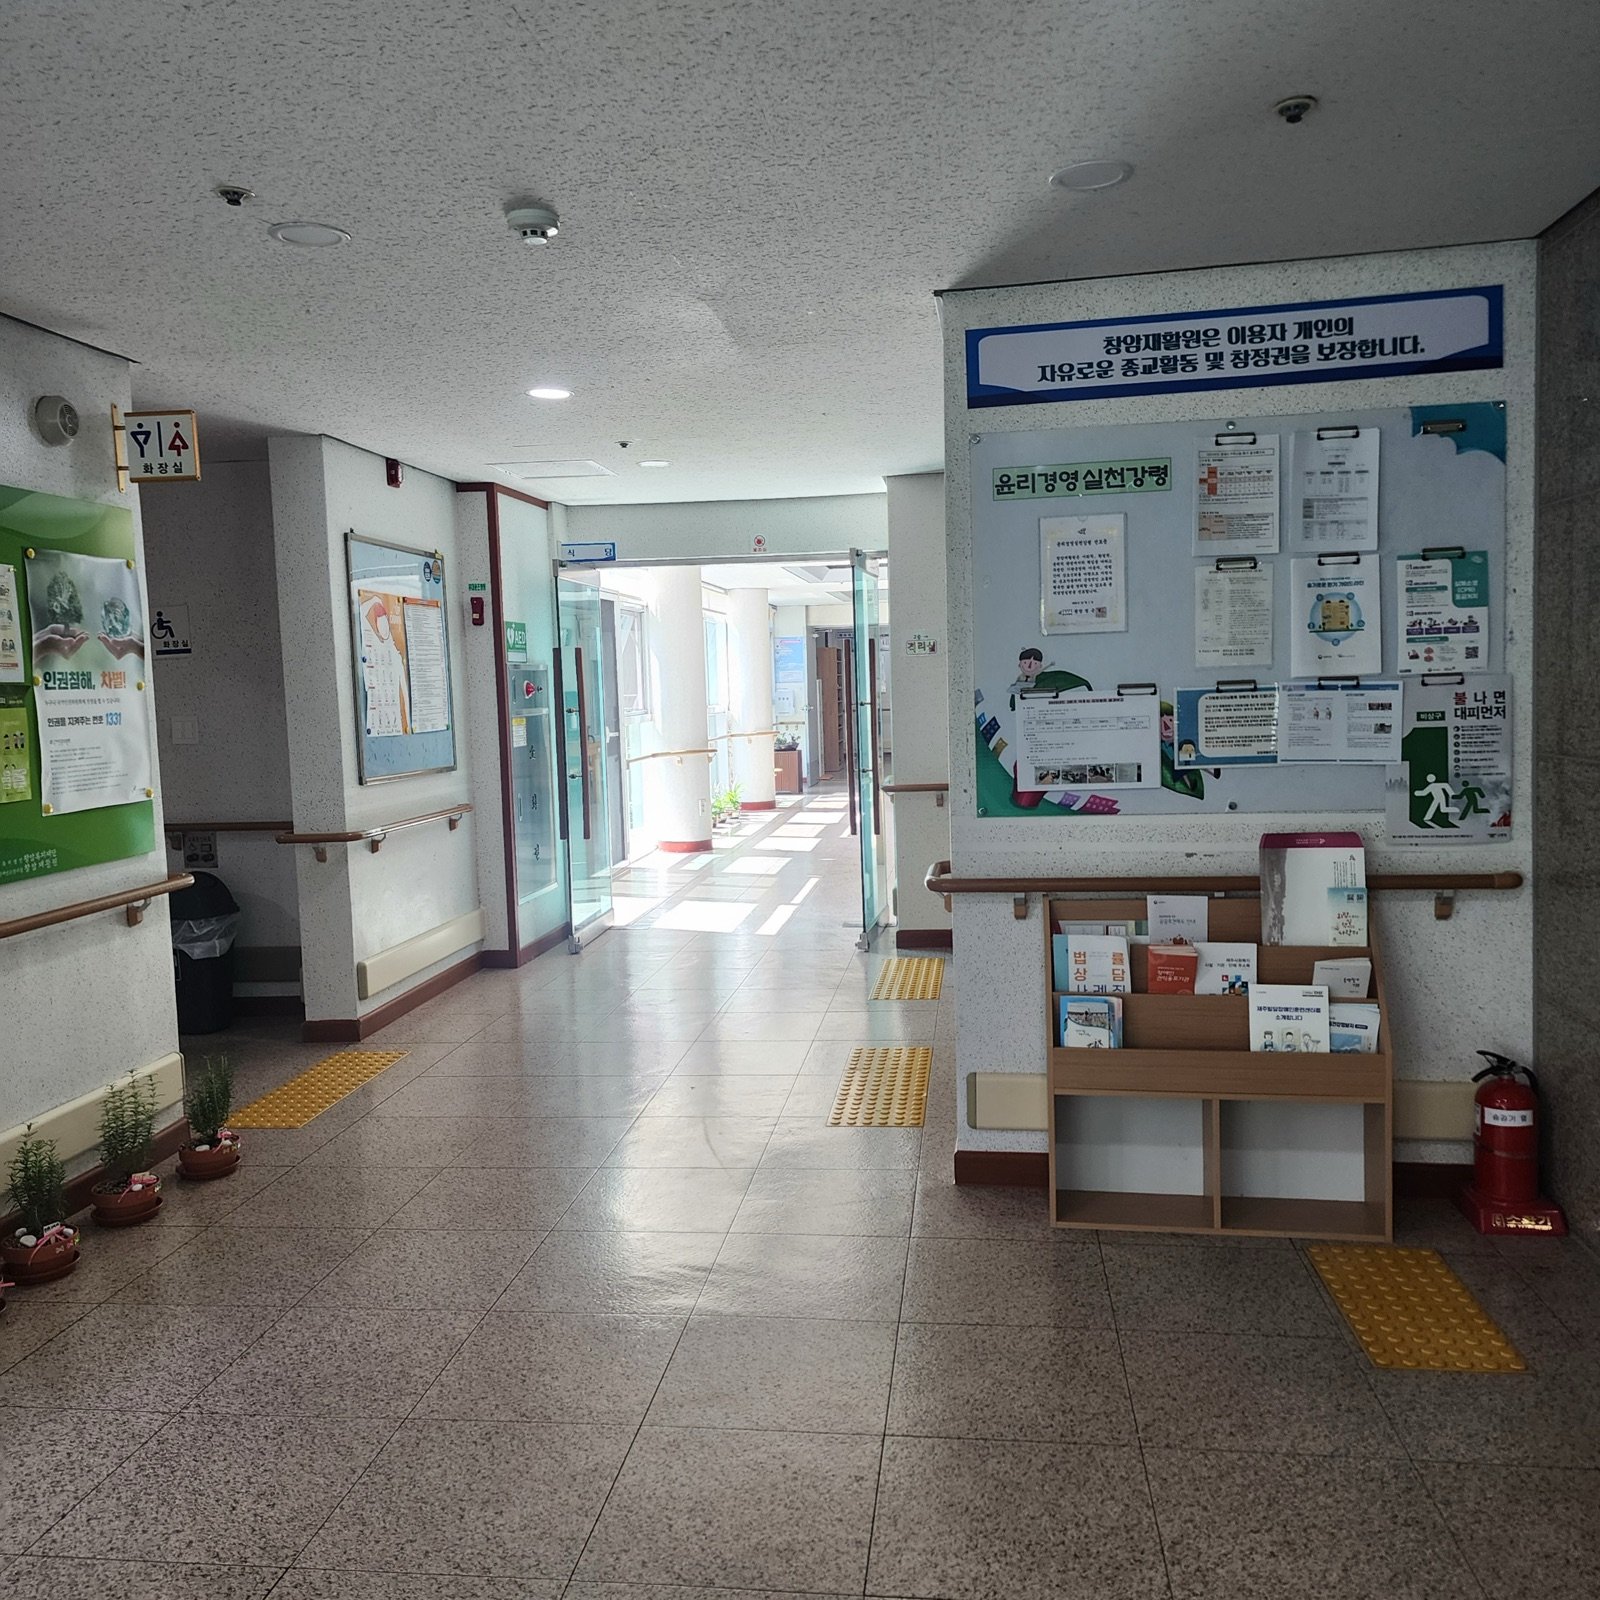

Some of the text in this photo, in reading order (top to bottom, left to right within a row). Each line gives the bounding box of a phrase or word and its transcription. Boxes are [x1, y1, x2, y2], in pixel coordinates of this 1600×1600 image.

[1103, 317, 1354, 355] 창암재활원은 이용자 개인의
[1038, 336, 1425, 382] 자유로운 종교활동 및 참정권을 보장합니다.
[142, 462, 184, 474] 화장실
[163, 640, 189, 648] 화장실
[514, 632, 526, 644] AED
[43, 671, 126, 690] 인권침해, 차별!
[47, 712, 122, 728] 인권을 지켜주는 번호 1331
[1454, 705, 1506, 720] 대피먼저
